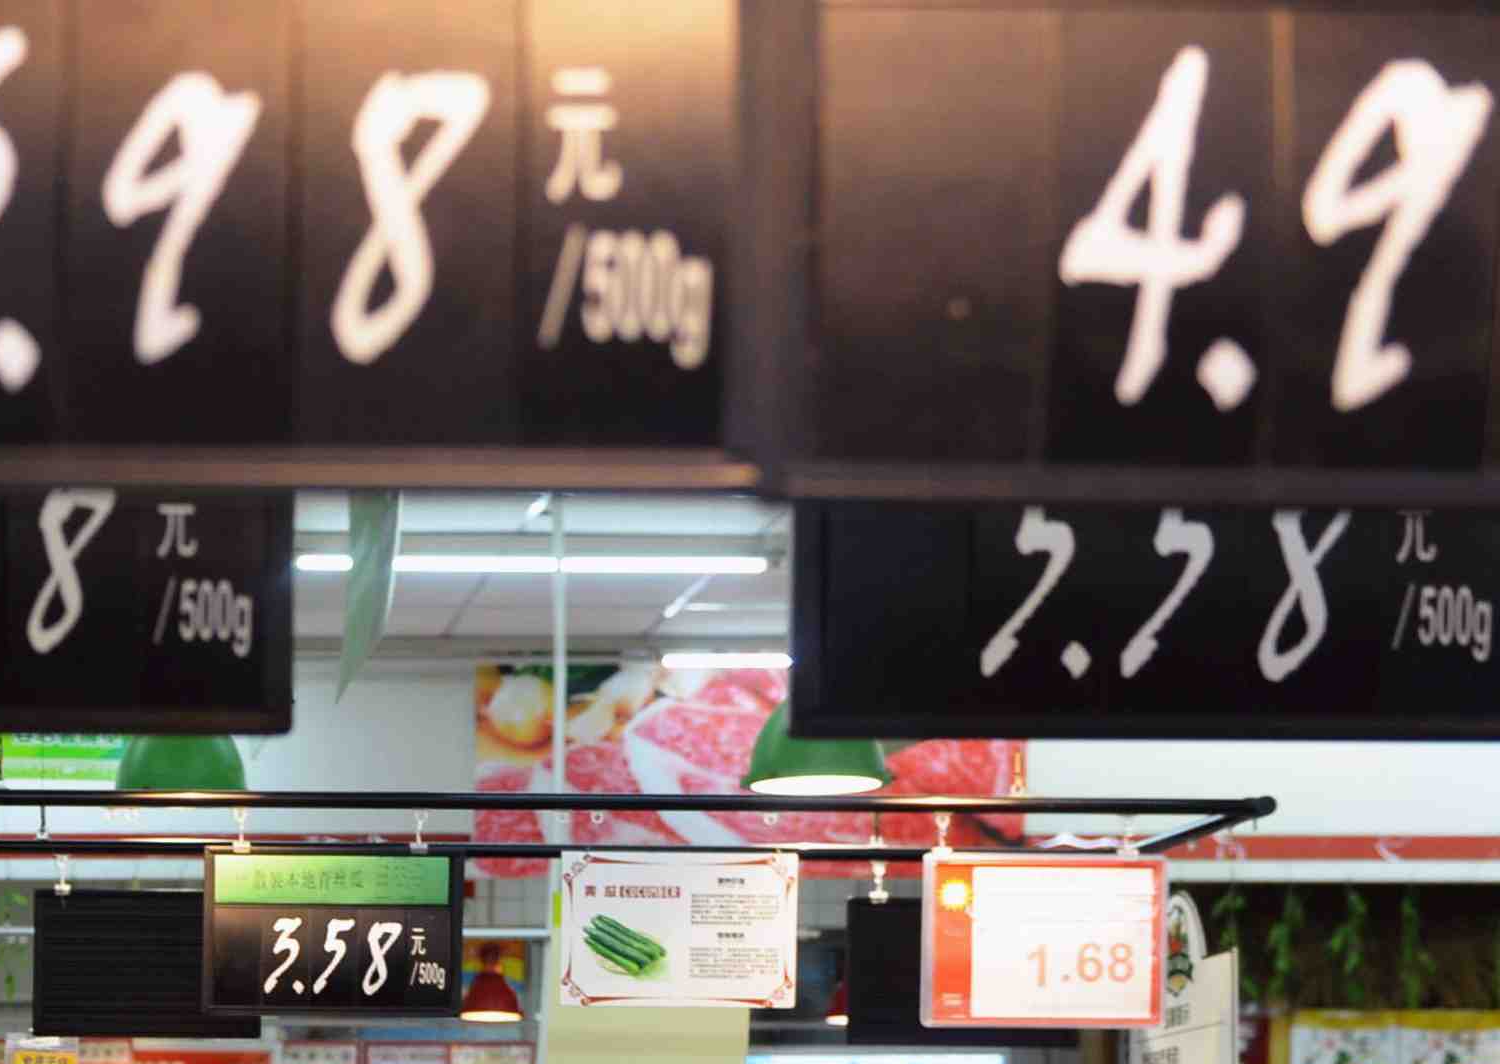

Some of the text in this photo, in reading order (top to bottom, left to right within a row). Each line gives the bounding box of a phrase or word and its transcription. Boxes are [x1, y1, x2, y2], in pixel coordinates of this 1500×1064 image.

[544, 67, 622, 202] 元
[1059, 44, 1493, 412] 4.9
[538, 225, 713, 368] /500g
[153, 576, 253, 657] /500g
[1393, 583, 1493, 662] /500g
[263, 916, 428, 996] 3.58 元
[409, 960, 447, 990] /500g
[1026, 942, 1136, 987] 1.68
